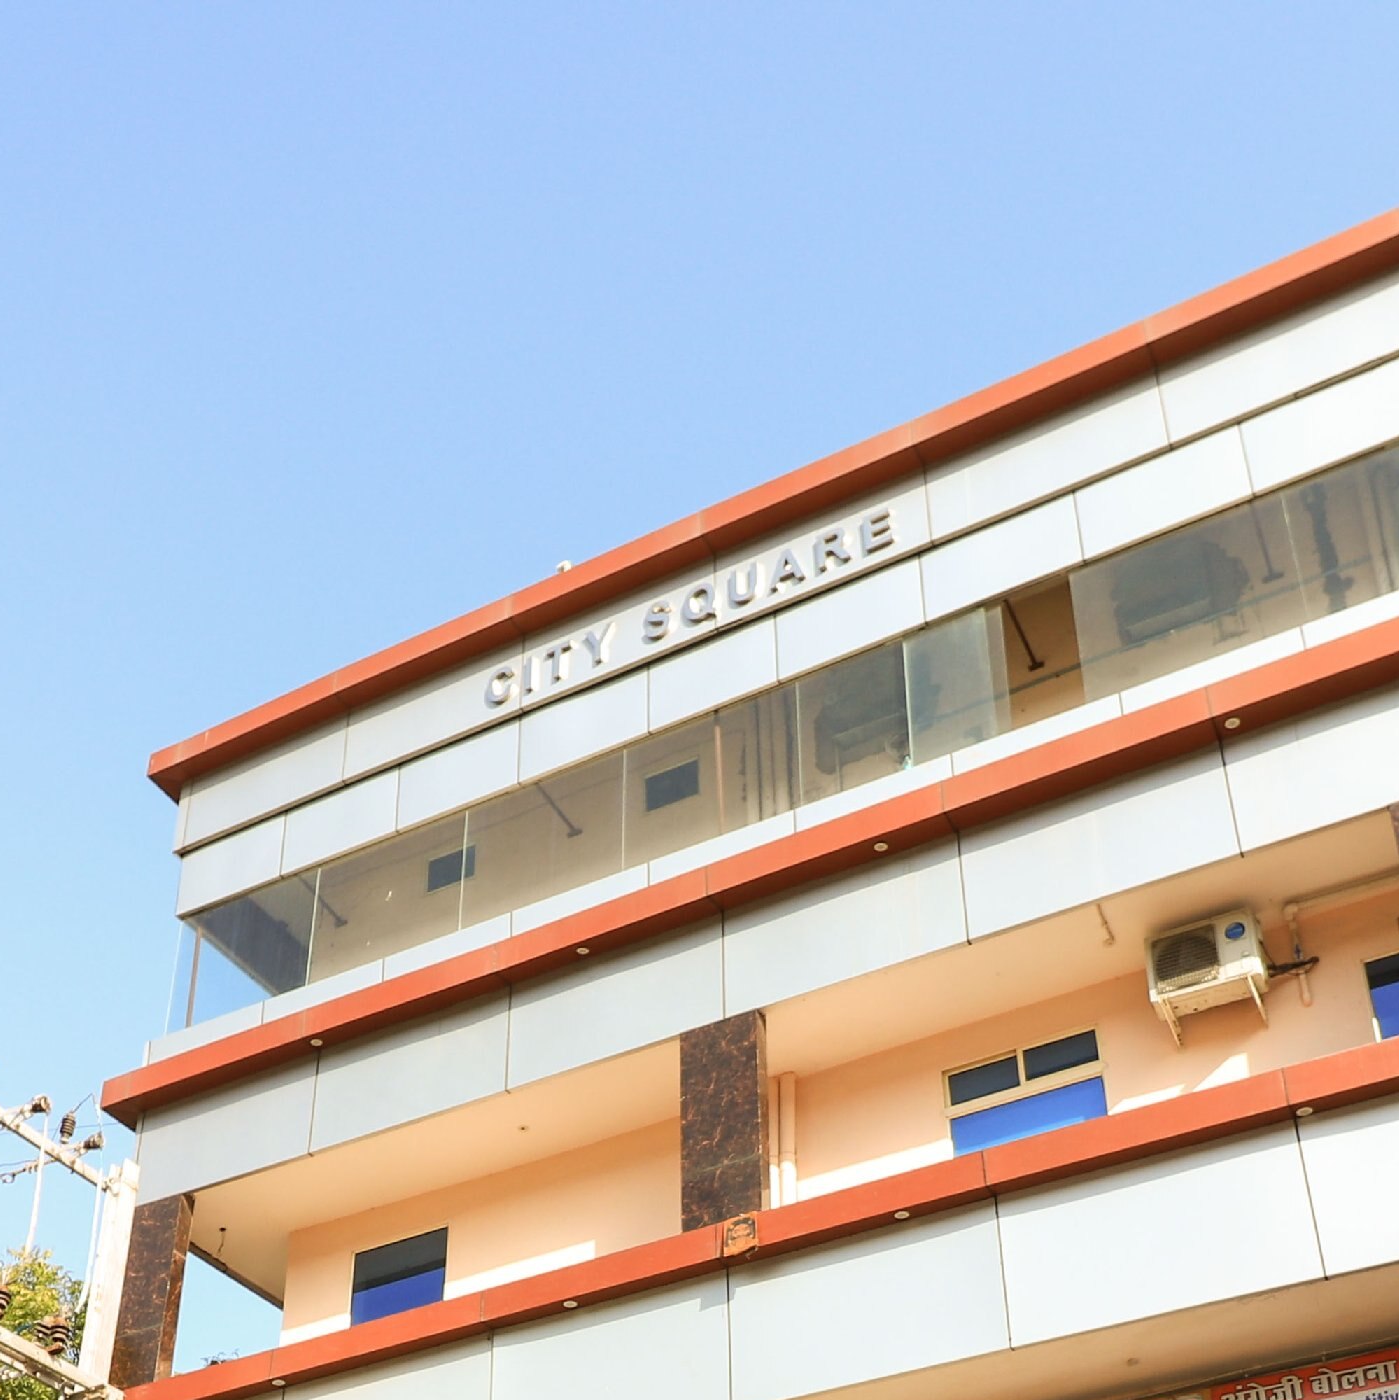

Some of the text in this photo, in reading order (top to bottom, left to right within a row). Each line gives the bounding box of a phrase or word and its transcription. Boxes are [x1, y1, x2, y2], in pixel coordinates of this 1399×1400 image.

[485, 507, 896, 708] CITY SQUARE
[1311, 1359, 1397, 1396] बोलना
